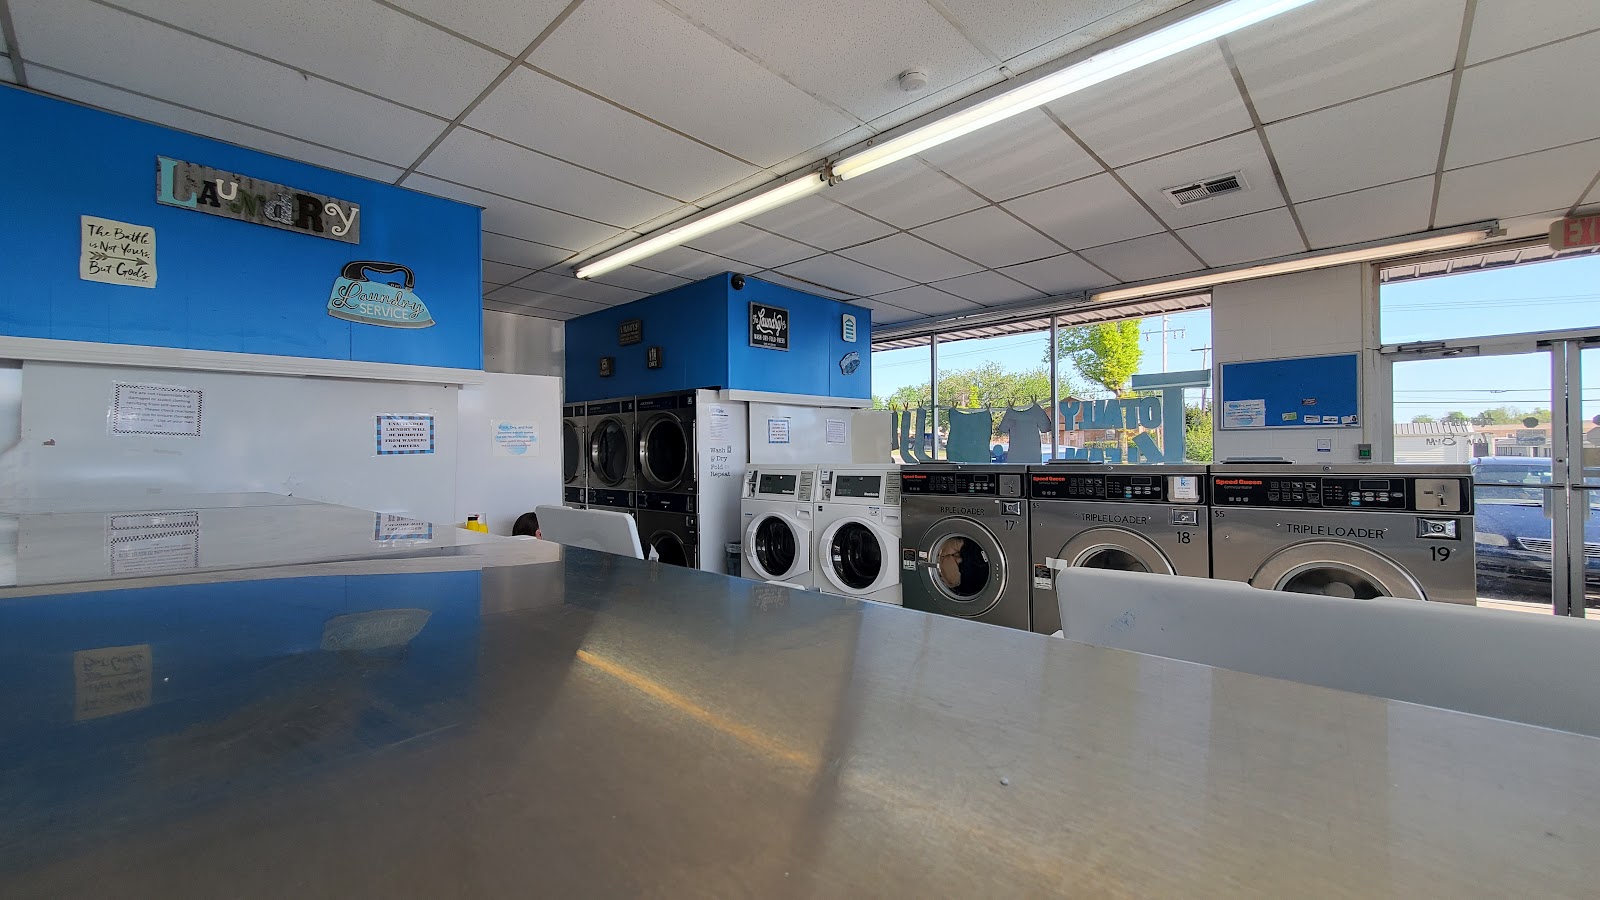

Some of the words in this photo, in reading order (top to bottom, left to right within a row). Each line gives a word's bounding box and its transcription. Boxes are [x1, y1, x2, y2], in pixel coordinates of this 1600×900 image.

[87, 224, 112, 237] The
[114, 228, 150, 245] Battle
[100, 240, 120, 254] Not
[89, 260, 116, 274] But
[116, 262, 150, 280] God's
[332, 281, 424, 319] Laundry
[360, 302, 410, 320] SERVICE
[756, 308, 782, 336] Laundry
[1005, 520, 1015, 530] 17
[1082, 512, 1107, 522] TRIPLE
[1108, 514, 1147, 524] LOADER
[1176, 531, 1190, 544] 18
[1286, 524, 1324, 535] TRIPLE
[1327, 526, 1384, 539] LOADER
[1430, 546, 1450, 562] 19
